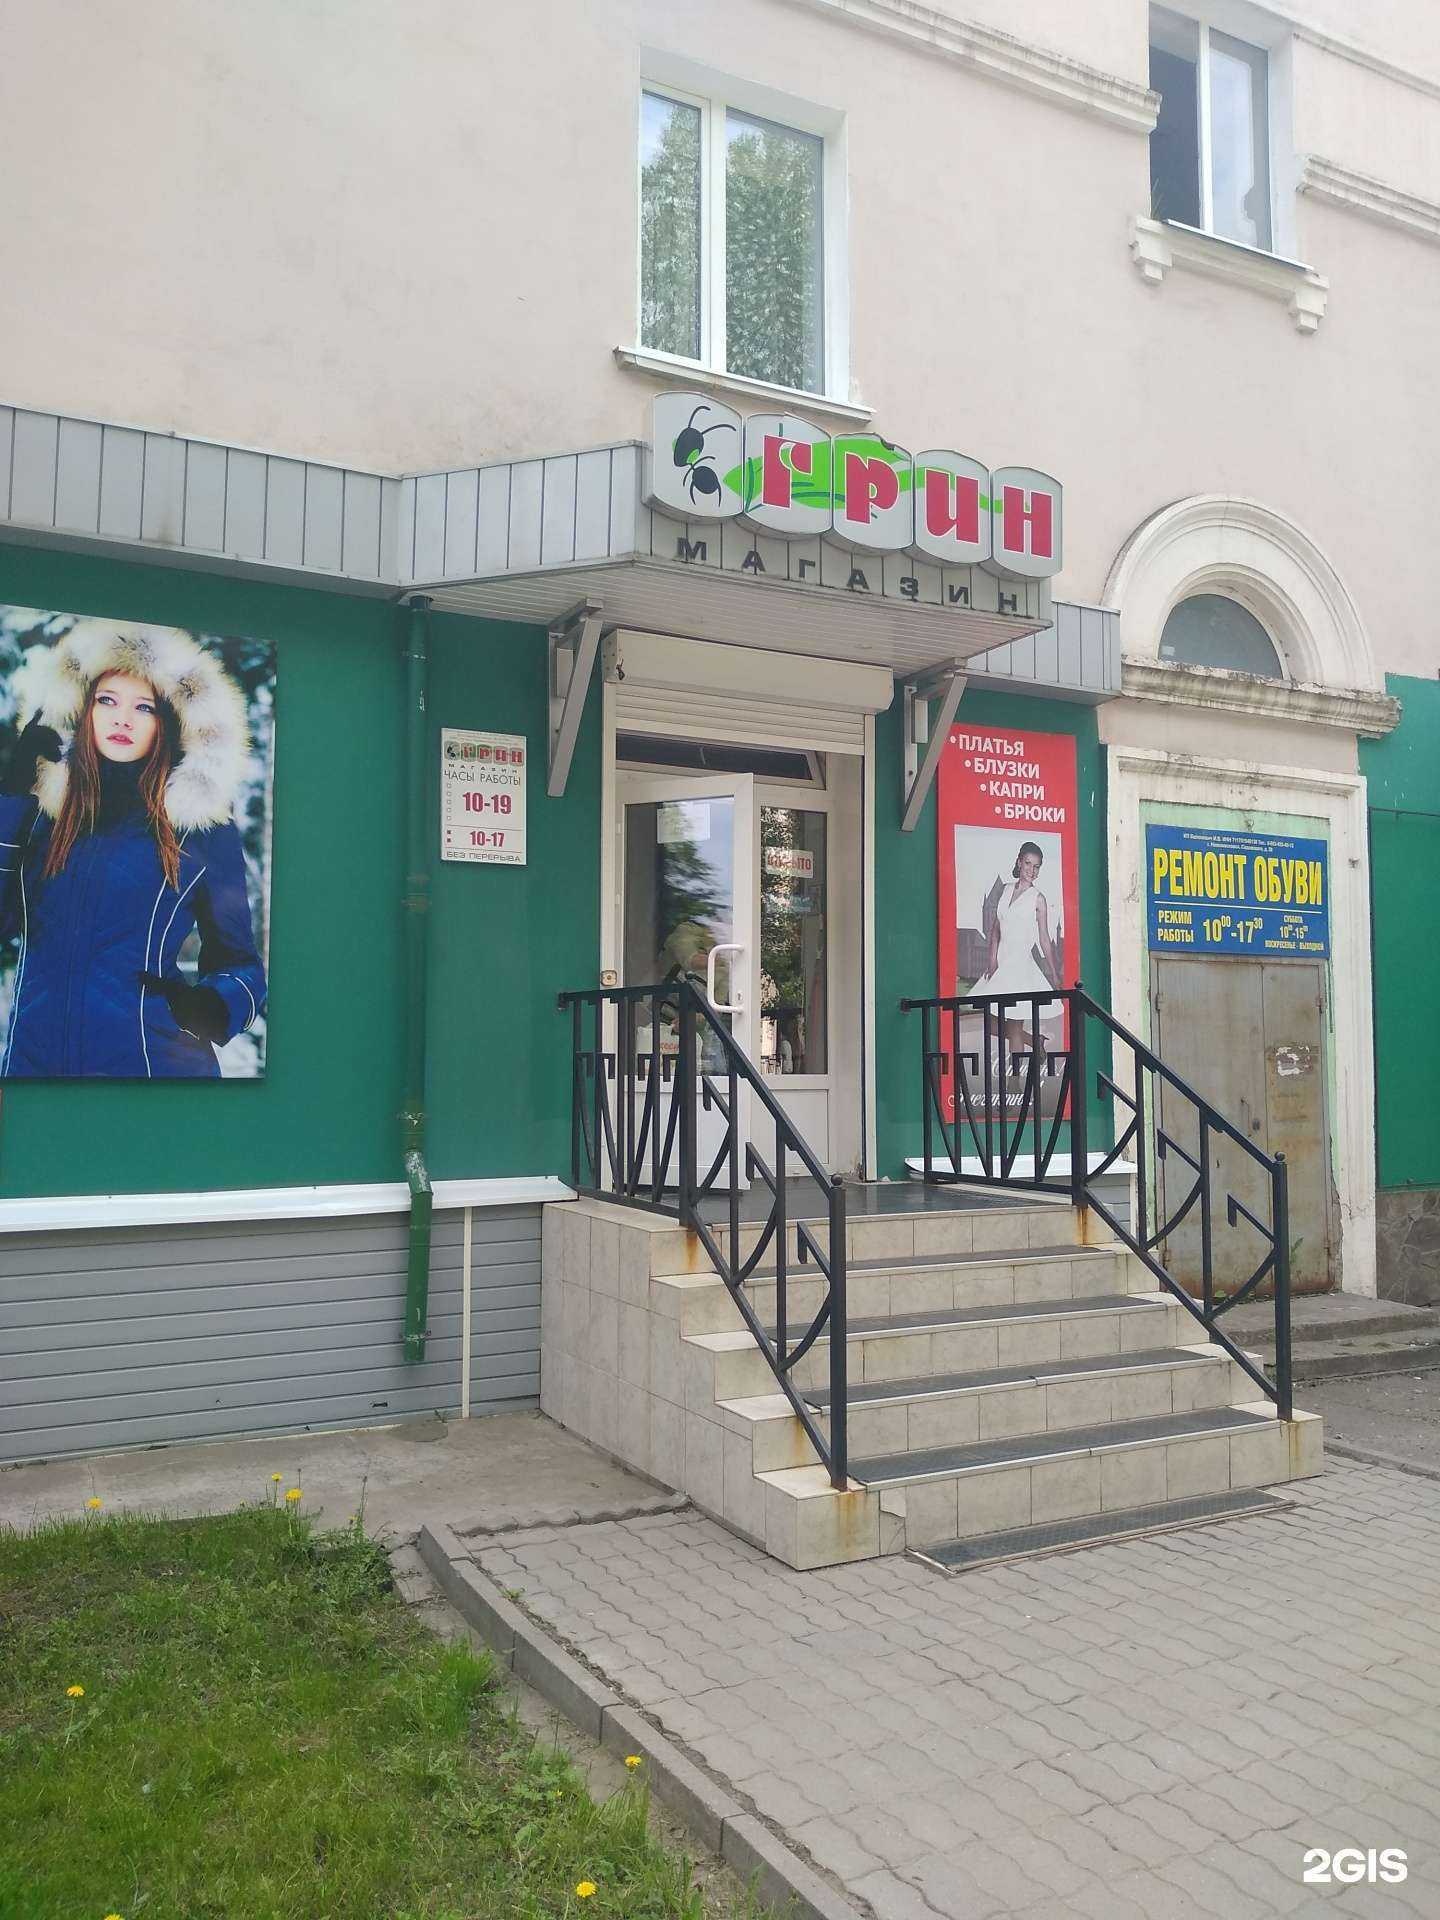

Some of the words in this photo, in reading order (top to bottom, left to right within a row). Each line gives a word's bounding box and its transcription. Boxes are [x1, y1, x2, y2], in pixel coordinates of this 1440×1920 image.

[676, 537, 1018, 612] МАГАЗИН
[959, 733, 1025, 756] ПЛАТЬЯ
[444, 770, 475, 782] ЧАСЫ
[480, 773, 521, 786] РАБОТЫ
[974, 757, 1040, 779] БЛУЗКИ
[989, 780, 1045, 800] КАПРИ
[462, 791, 512, 815] 10-19
[1004, 803, 1066, 823] БРЮКИ
[470, 830, 505, 847] 10-17
[447, 851, 466, 859] БЕЗ
[469, 852, 521, 862] ПЕРЕРЫВА
[1153, 847, 1247, 900] РЕМОНТ
[1253, 855, 1323, 906] ОБУВИ
[1158, 910, 1192, 925] РЕЖИМ
[1157, 928, 1194, 943] РАБОТЫ
